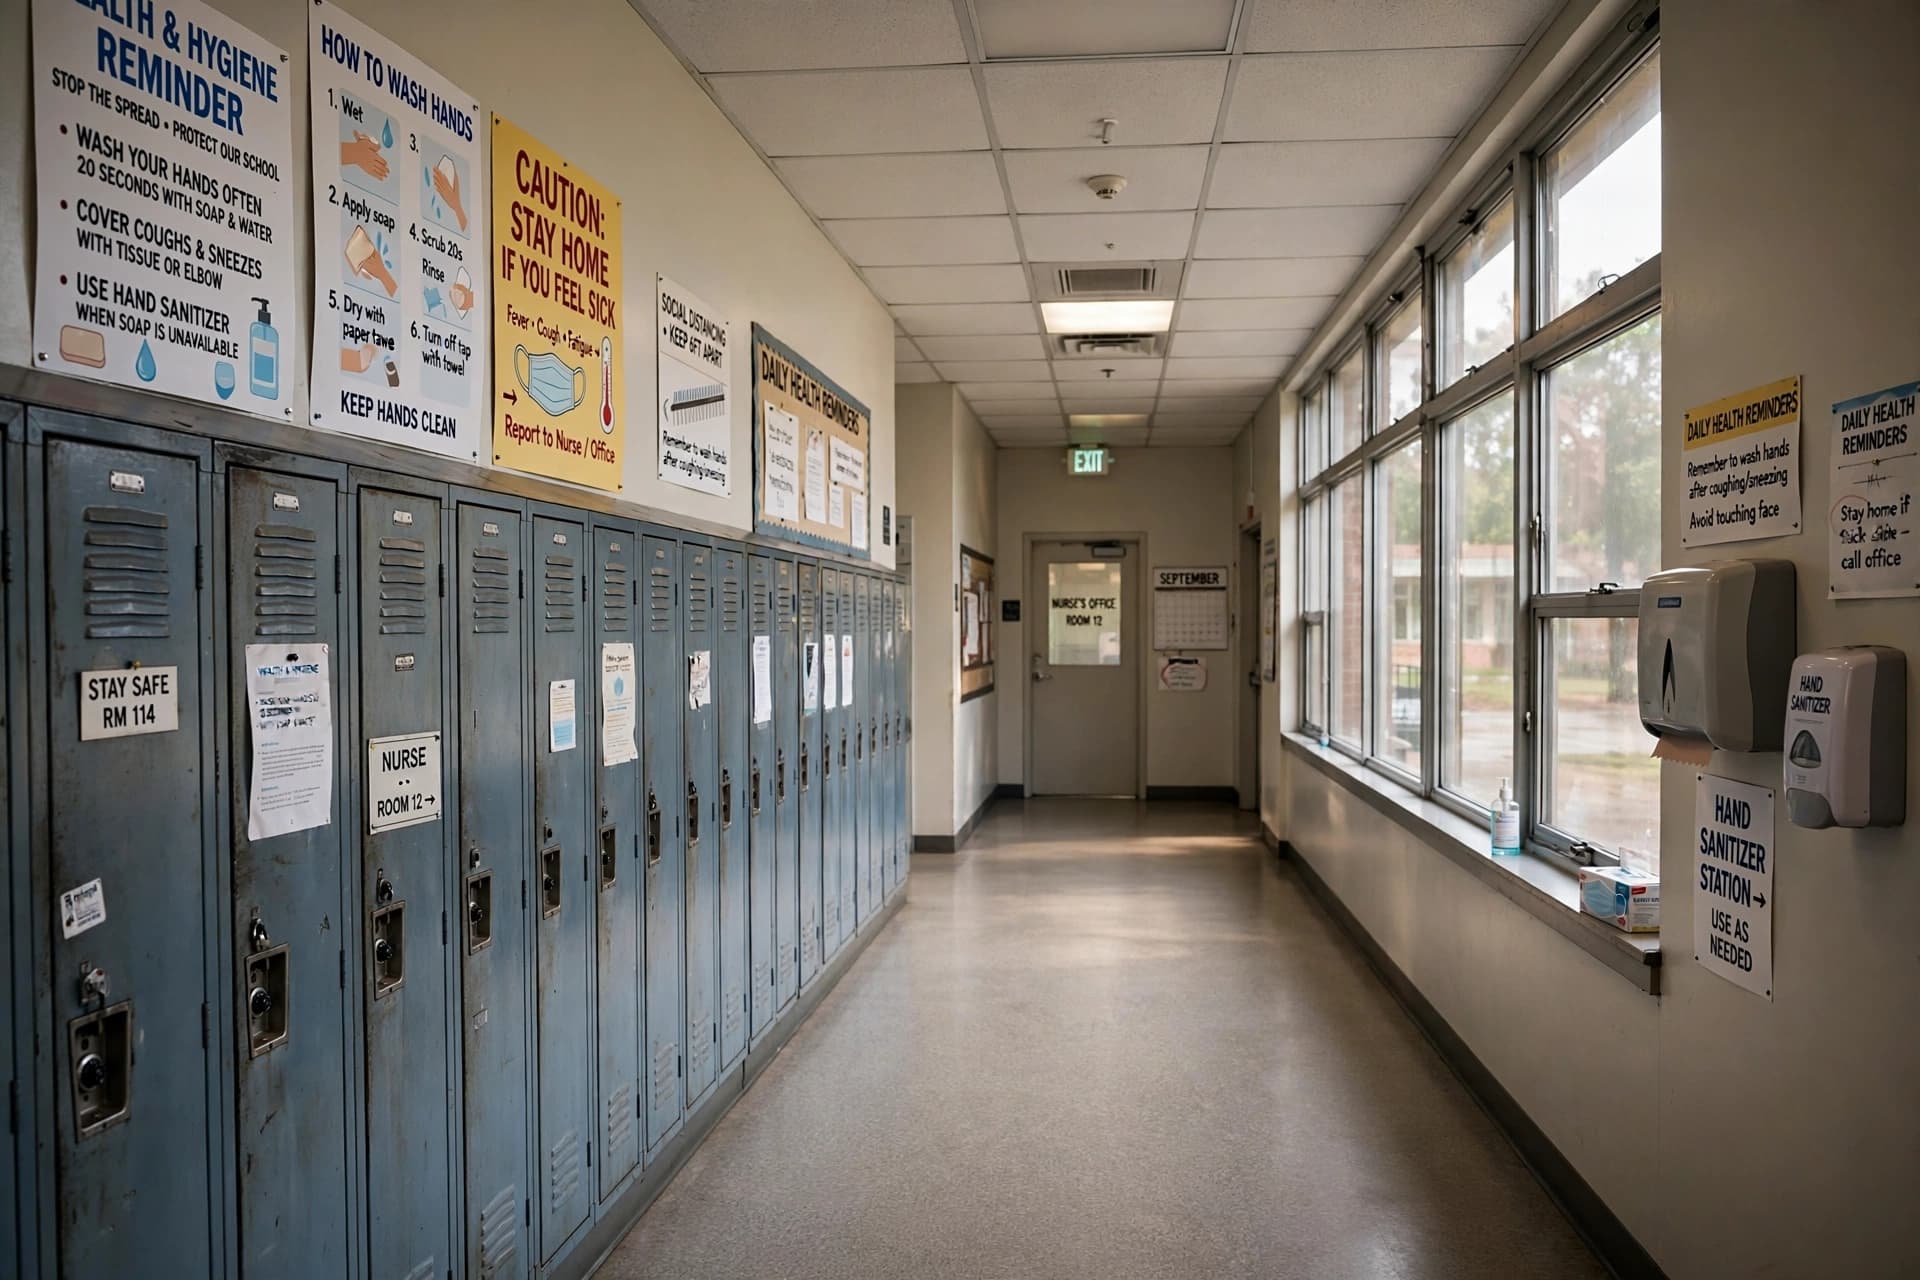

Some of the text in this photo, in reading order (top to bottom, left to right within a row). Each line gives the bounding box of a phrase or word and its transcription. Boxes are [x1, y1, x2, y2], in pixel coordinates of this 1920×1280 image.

[163, 11, 181, 52] &
[188, 22, 278, 103] HYGIENE
[97, 26, 243, 135] REMINDER
[322, 24, 472, 142] HOW TO WASH HANDS
[52, 67, 280, 182] STOP THE SPREAD PROTECT OUR SCHOOL
[328, 88, 363, 123] 1. Wet
[409, 133, 419, 153] 3.
[76, 123, 262, 217] WASH YOUR HANDS OFTEN
[77, 155, 273, 244] 20 SECONDS WITH SOAP & WATER
[328, 185, 395, 233] 2. Apply soap
[516, 149, 605, 241] CAUTION:
[76, 199, 262, 279] COVER COUGHS & SNEEZES
[76, 227, 223, 290] WITH TISSUE OR ELBOW
[409, 223, 463, 262] 4. Scrub 20s
[511, 201, 609, 288] STAY HOME
[422, 258, 445, 282] Rinse
[502, 245, 616, 330] IF YOU FEEL SICK
[76, 272, 230, 335] USE HAND SANITIZER
[329, 289, 385, 325] 5. Dry with
[662, 293, 688, 325] SOCIAL
[76, 301, 239, 360] WHEN SOAP IS UNAVAILABLE
[342, 322, 370, 345] paper
[410, 321, 471, 361] 6. Turn off tap
[507, 304, 529, 331] Fever
[537, 317, 561, 346] Cough
[422, 349, 465, 376] with towel
[669, 323, 688, 349] KEEP
[703, 343, 722, 368] APART
[762, 351, 788, 391] DAILY
[790, 367, 821, 413] HEALTH
[823, 388, 859, 436] REMINDERS
[340, 390, 456, 439] KEEP HANDS CLEAN
[1687, 390, 1798, 442] DAILY HEALTH REMINDERS
[1841, 396, 1915, 432] DAILY HEALTH
[505, 414, 615, 464] Report to Nurse / Office
[1687, 438, 1790, 478] Remember to wash hands
[1842, 425, 1908, 455] REMINDERS
[1074, 449, 1104, 472] EXIT
[1689, 467, 1788, 499] after coughing/sneezing
[1689, 499, 1780, 529] Avoid touching face
[1841, 494, 1911, 524] Stay home if
[1841, 548, 1901, 569] call office
[1160, 572, 1220, 585] SEPTEMBER
[1052, 598, 1116, 609] NURSE'S OFFICE
[1066, 615, 1103, 626] ROOM 12
[89, 674, 169, 701] STAY SAFE
[1800, 675, 1823, 693] HAND
[103, 704, 155, 728] RM 114
[1791, 695, 1831, 715] SANITIZER
[382, 746, 426, 772] NURSE
[377, 793, 422, 817] ROOM 12
[1715, 794, 1751, 830] HAND
[1700, 827, 1766, 874] SANITIZER
[1700, 863, 1751, 908] STATION
[1711, 908, 1750, 943] USE AS
[1710, 934, 1753, 973] NEEDED
